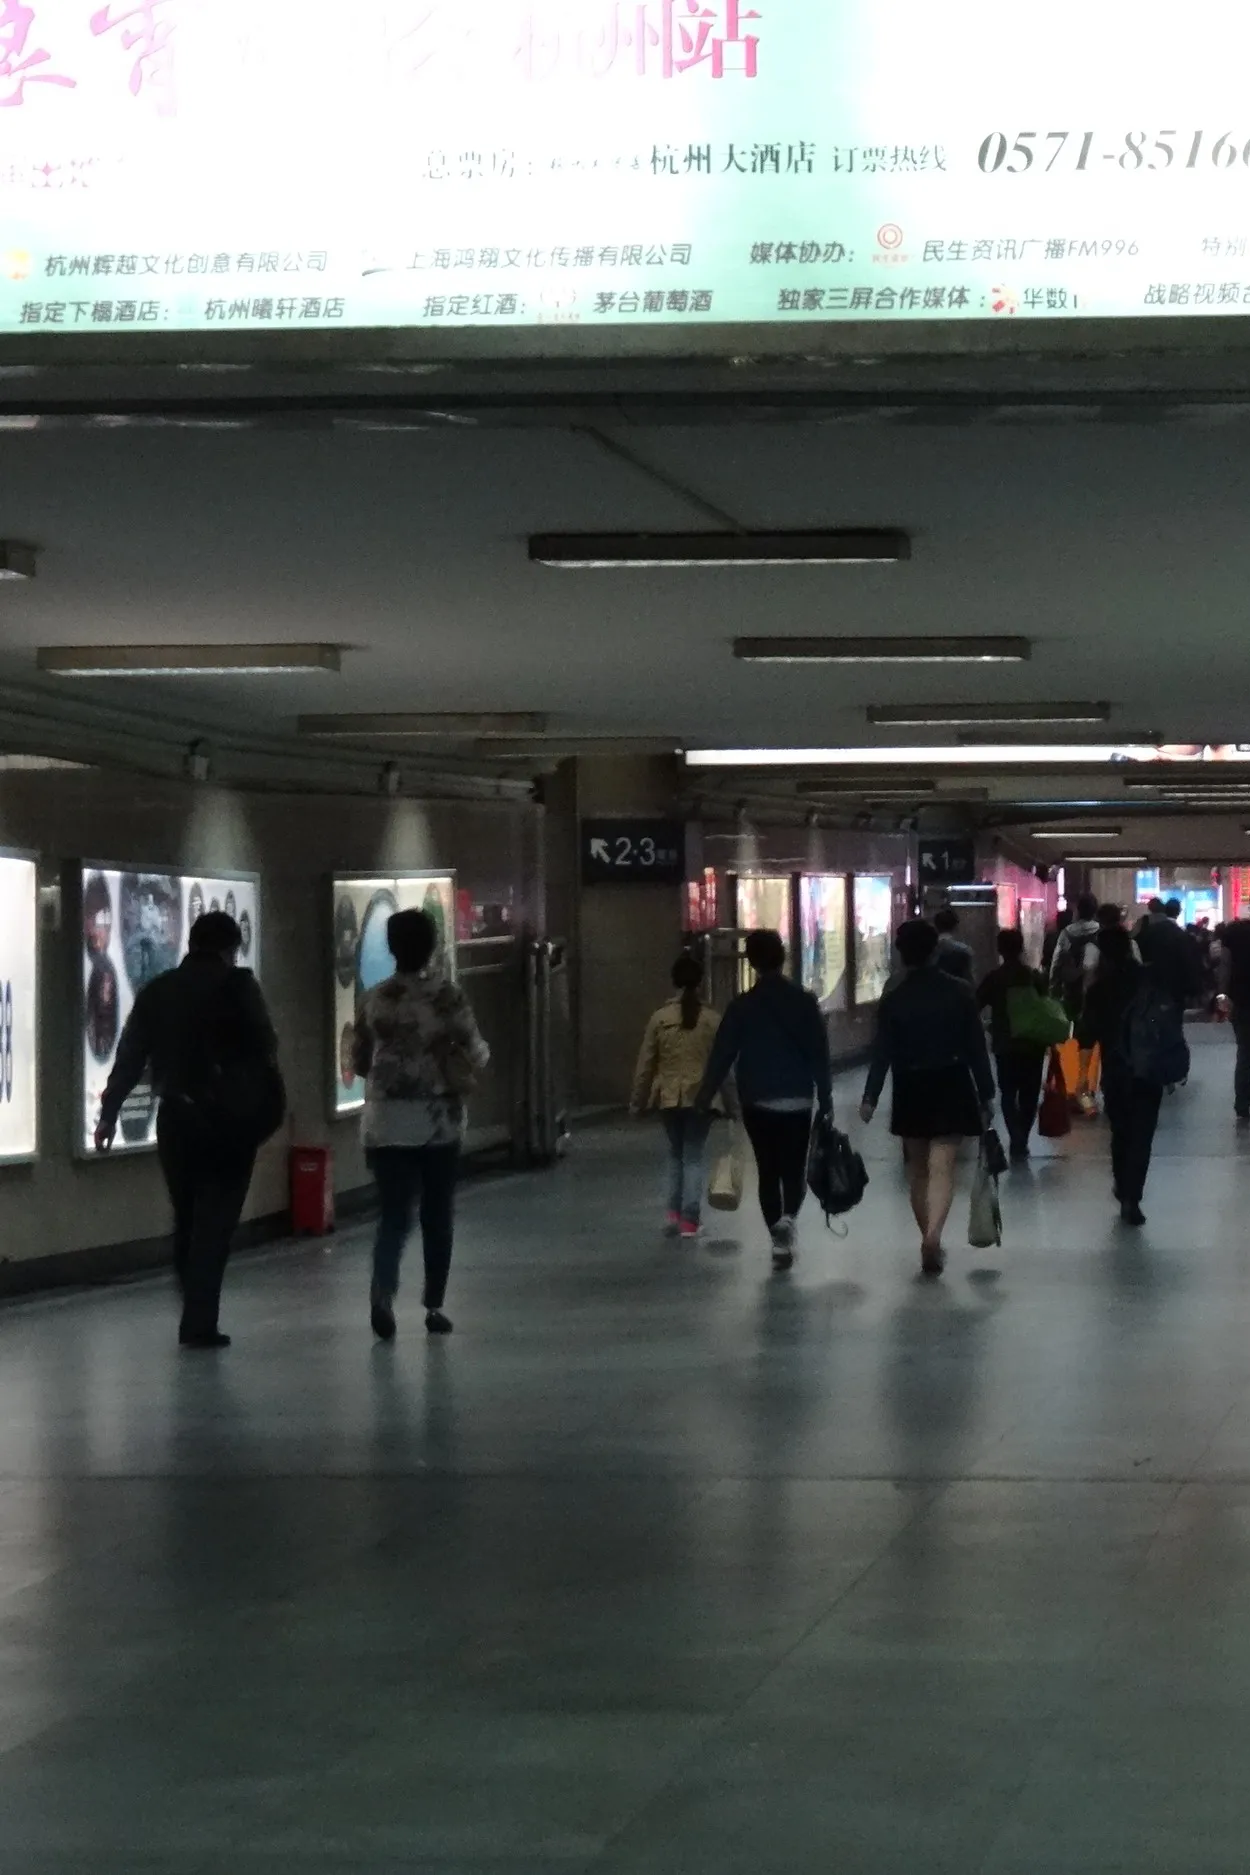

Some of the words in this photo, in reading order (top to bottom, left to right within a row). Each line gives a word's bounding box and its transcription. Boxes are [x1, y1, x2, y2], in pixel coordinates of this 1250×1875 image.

[650, 143, 817, 176] 杭州大酒店
[832, 144, 948, 174] 订票热线
[44, 249, 329, 279] 杭州辉越文化创意有限公司
[405, 242, 693, 271] 上海鸿翔文化传播有限公司
[749, 239, 855, 266] 媒体协办：
[592, 288, 715, 315] 茅台葡萄酒
[777, 285, 987, 313] 独家三屏合作媒体：
